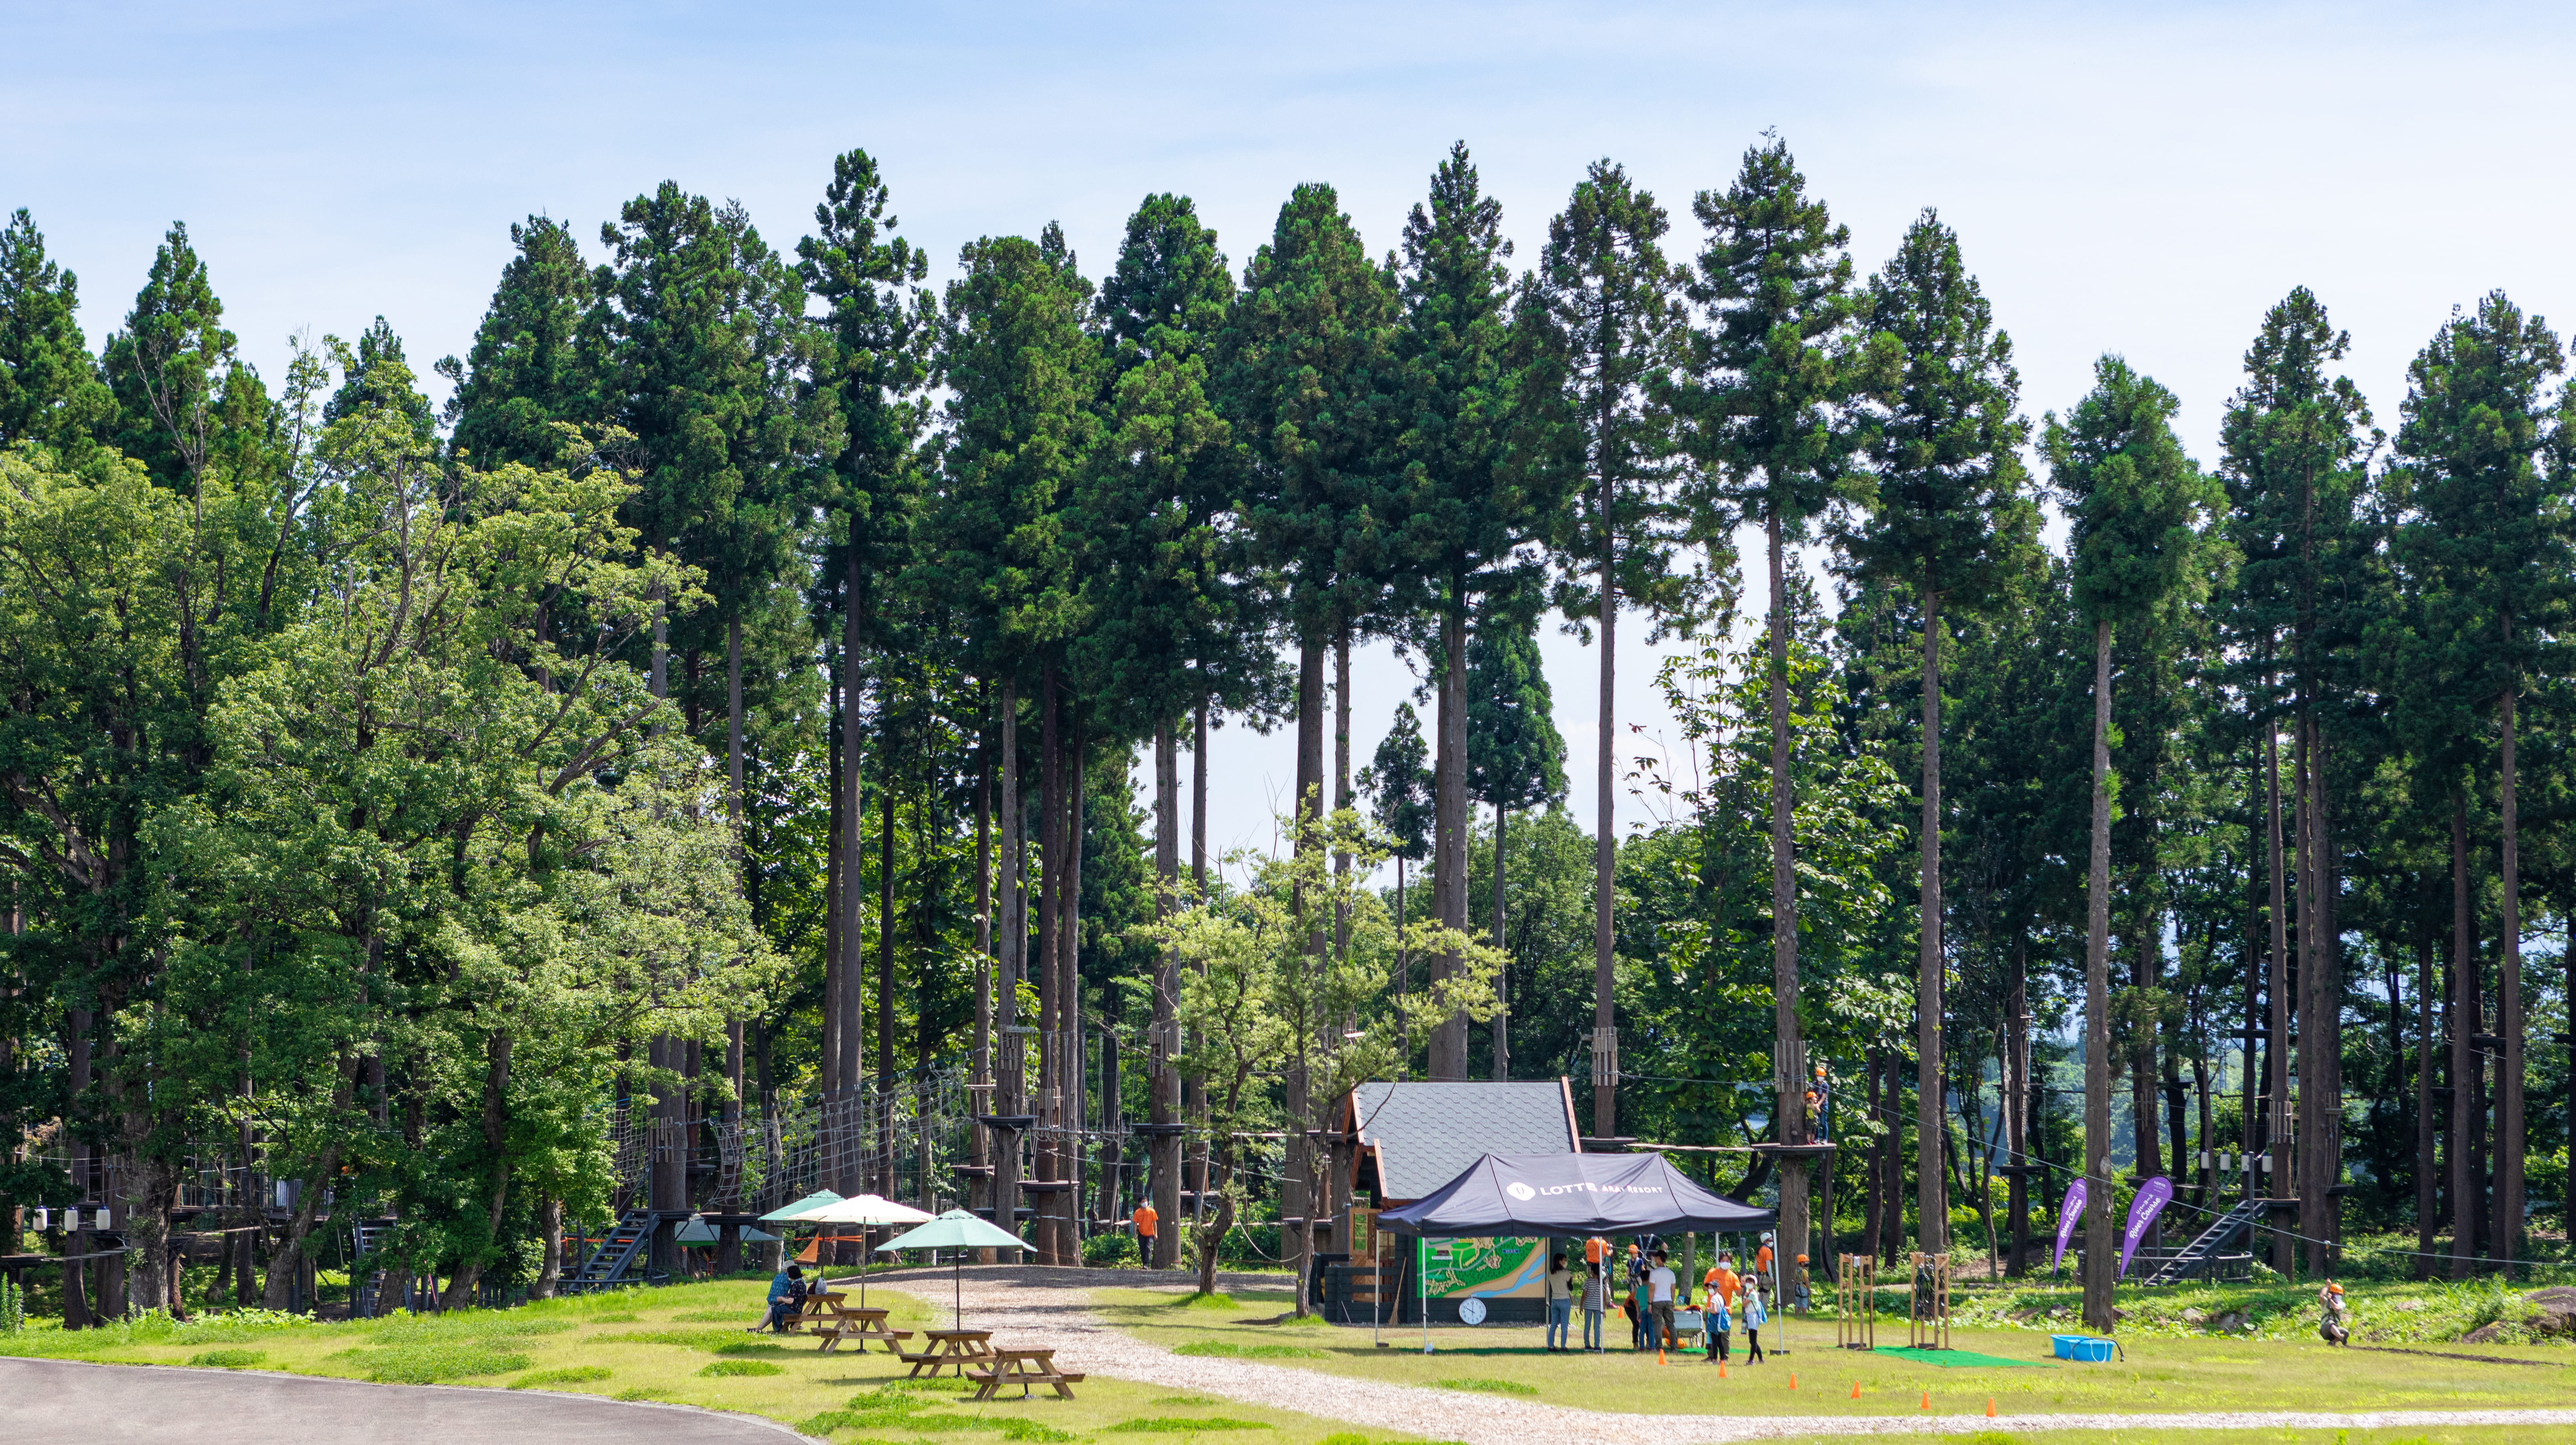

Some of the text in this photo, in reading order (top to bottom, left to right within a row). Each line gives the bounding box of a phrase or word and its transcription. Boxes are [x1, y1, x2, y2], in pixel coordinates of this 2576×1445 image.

[1540, 1182, 1598, 1195] LOTTE
[1627, 1185, 1662, 1193] RESORT
[2129, 1220, 2144, 1239] River
[2141, 1197, 2161, 1220] Course
